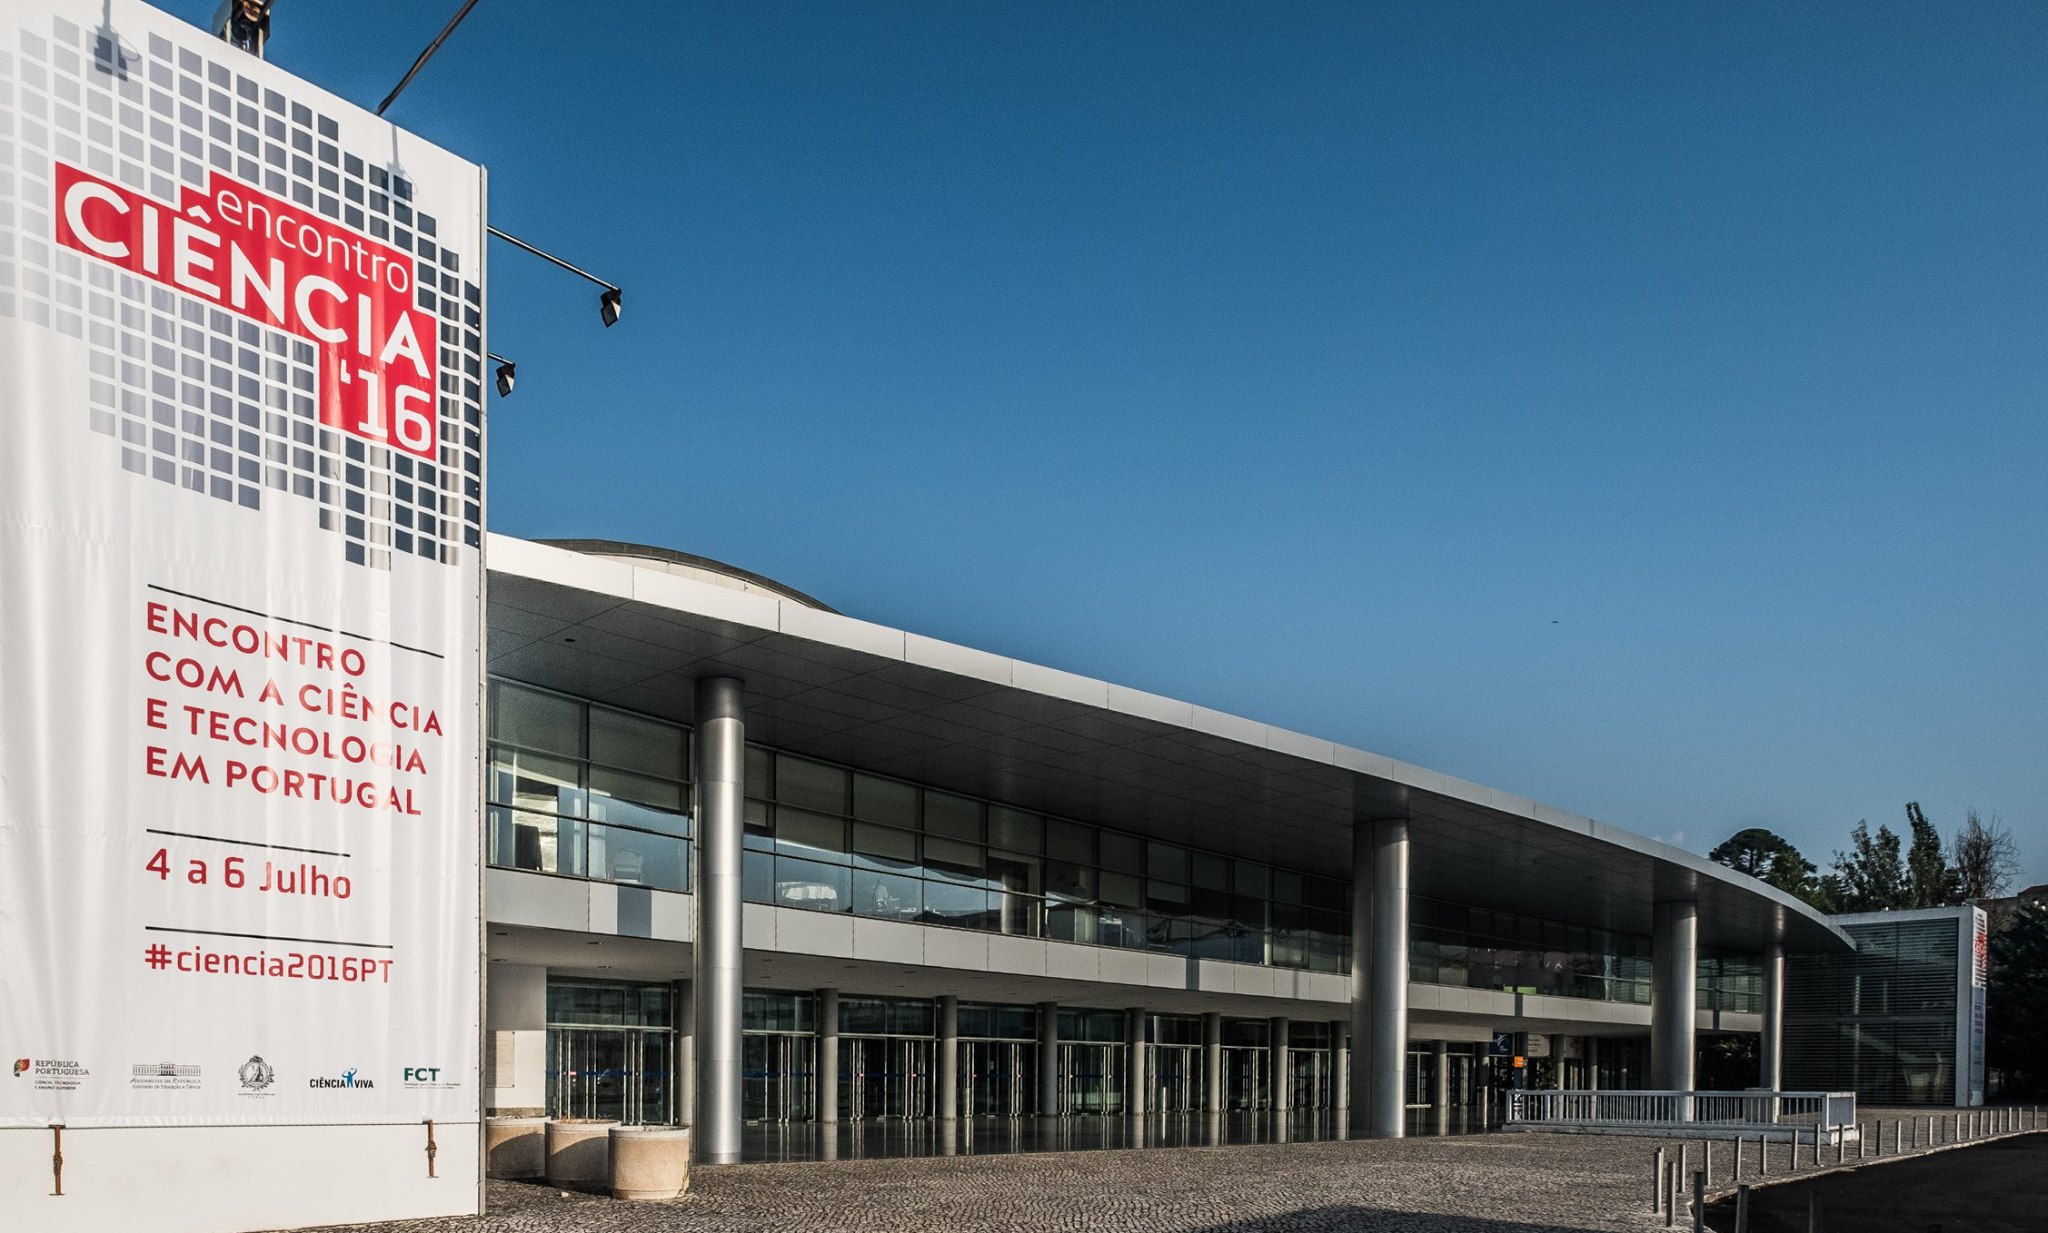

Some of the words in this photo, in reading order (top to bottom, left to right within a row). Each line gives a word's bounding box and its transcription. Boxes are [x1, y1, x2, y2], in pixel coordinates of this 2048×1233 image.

[218, 191, 408, 292] encontro
[65, 182, 430, 379] CIÊNCIA
[146, 602, 366, 678] ENCONTRO
[144, 651, 244, 699] COM
[258, 678, 284, 706] A
[298, 683, 443, 737] CIÊNCIA
[145, 698, 169, 730] E
[183, 704, 427, 775] TECNOLOGIA
[145, 745, 210, 784] EM
[225, 759, 422, 816] PORTUGAL
[145, 848, 172, 881] 4
[186, 858, 208, 885] a
[223, 855, 246, 889] 6
[259, 860, 352, 900] Julho
[144, 944, 394, 983] #ciencia2016PT
[35, 1059, 79, 1068] REPÚBLICA
[35, 1068, 90, 1076] PORTUGUESA
[310, 1076, 346, 1088] CIÊNCIA
[354, 1079, 374, 1088] VIVA
[404, 1067, 441, 1082] FCT
